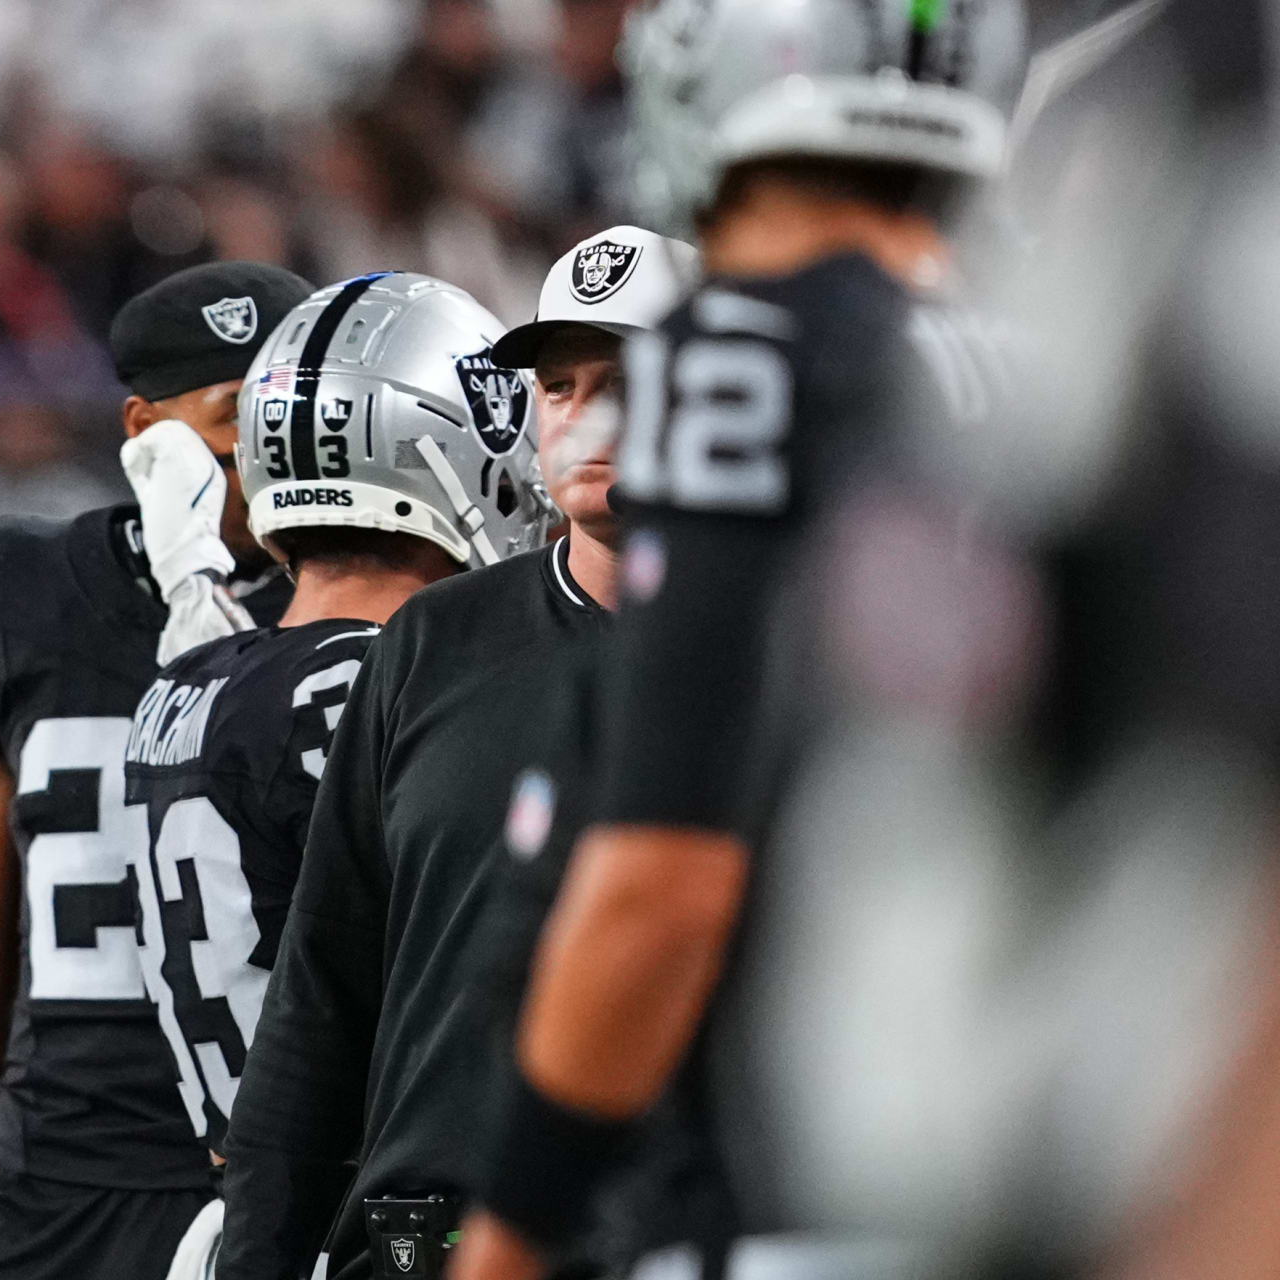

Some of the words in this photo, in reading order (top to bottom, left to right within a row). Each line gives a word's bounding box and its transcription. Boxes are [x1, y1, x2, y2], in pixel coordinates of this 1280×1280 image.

[579, 245, 630, 258] RAIDERS
[618, 328, 794, 516] 12
[273, 488, 353, 509] RAIDERS
